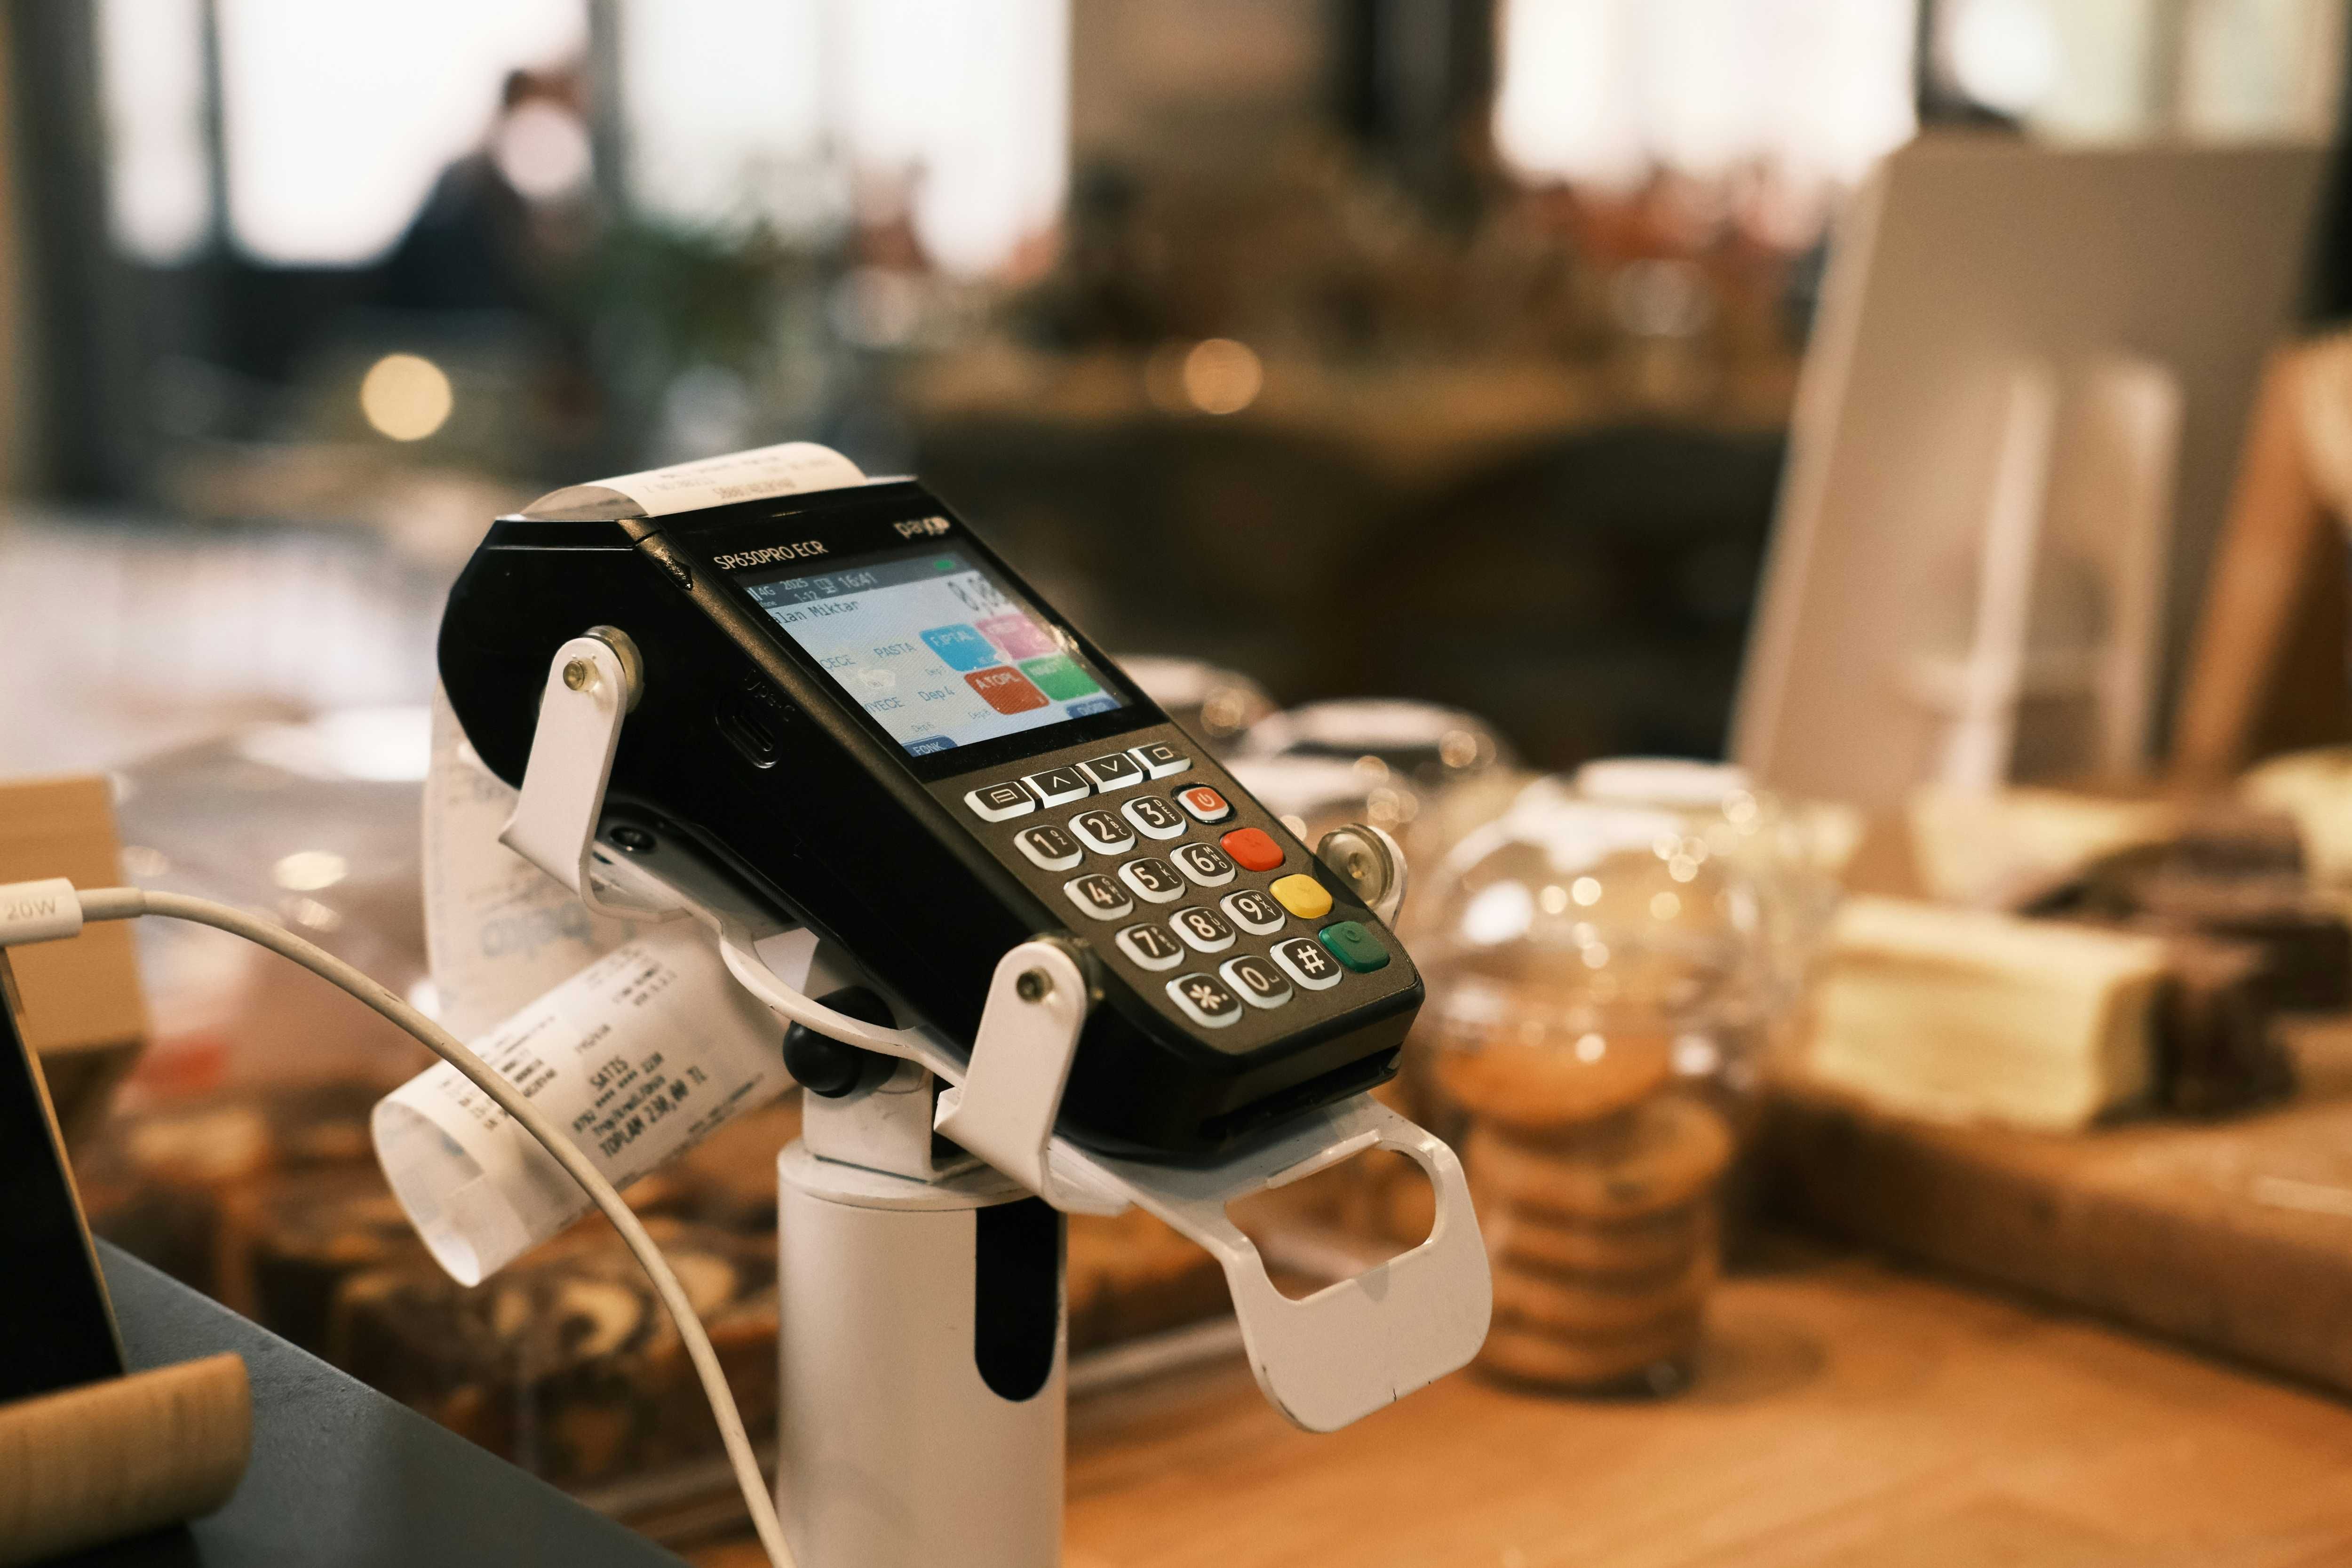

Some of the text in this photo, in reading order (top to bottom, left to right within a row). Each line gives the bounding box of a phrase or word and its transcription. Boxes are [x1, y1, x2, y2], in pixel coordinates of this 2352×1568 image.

[713, 540, 830, 570] SP630PRO ECR
[758, 586, 776, 596] 4G
[779, 578, 809, 590] 2025
[838, 571, 878, 589] 16:41
[807, 600, 859, 617] Miktar
[873, 642, 916, 658] PASTA
[918, 689, 946, 702] Dep
[944, 686, 955, 696] 4
[1137, 799, 1176, 825] 3 DEF
[1088, 818, 1116, 841] 2
[1033, 833, 1058, 855] 1
[1191, 846, 1228, 872] 6 MNO
[1133, 867, 1159, 890] 5
[1088, 881, 1114, 905] 4
[7, 897, 56, 920] 20W
[1238, 893, 1276, 921] 9 WXY
[1189, 915, 1216, 938] 8
[1133, 930, 1160, 957] 7
